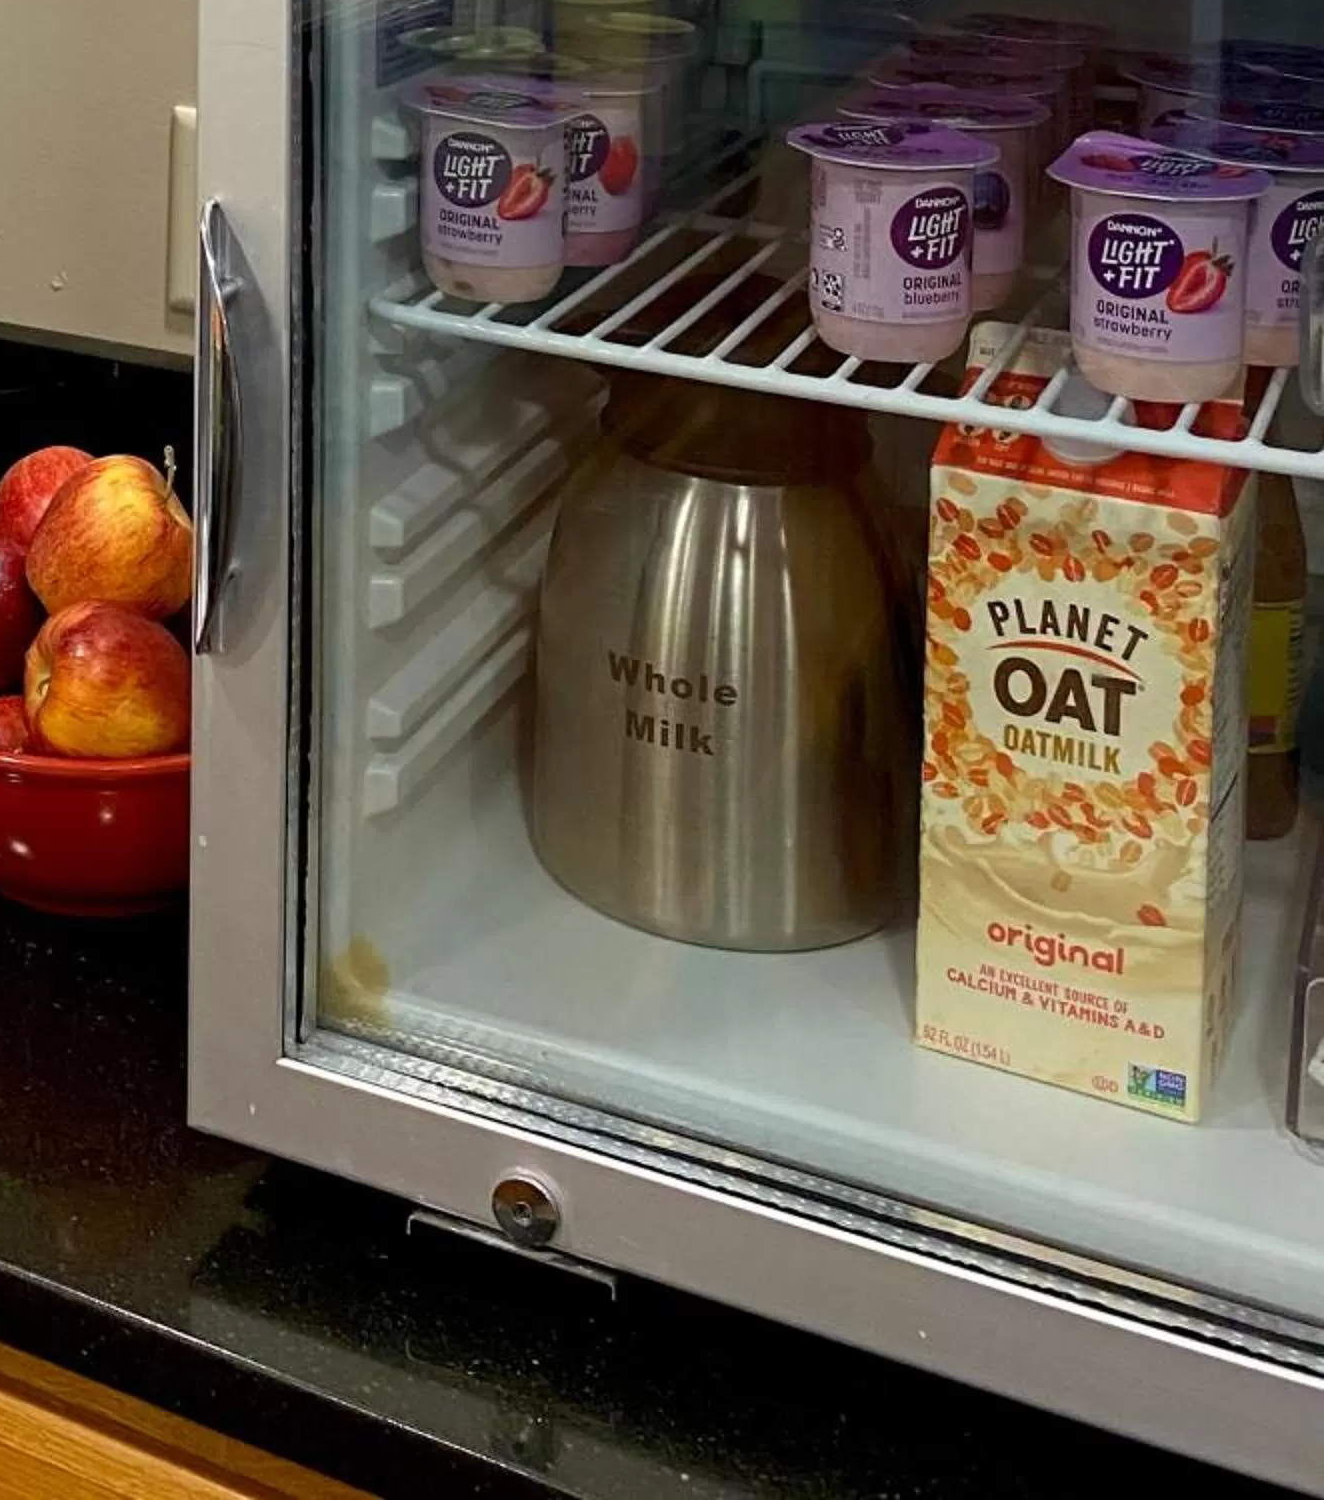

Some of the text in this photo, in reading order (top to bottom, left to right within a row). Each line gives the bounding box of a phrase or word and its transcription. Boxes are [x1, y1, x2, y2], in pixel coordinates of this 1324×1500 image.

[443, 153, 500, 177] LIGHT
[437, 224, 503, 246] strawberry
[439, 208, 501, 230] ORIGINAL
[907, 207, 962, 242] LIGHT
[1107, 220, 1157, 237] DANNON
[1101, 238, 1169, 265] LIGHT
[903, 272, 963, 291] ORIGINAL
[1093, 316, 1173, 341] strawberry
[1096, 299, 1169, 325] ORIGINAL
[987, 598, 1149, 661] PLANET
[608, 651, 738, 707] Whole
[993, 656, 1137, 738] OAT
[626, 709, 714, 756] Milk
[1004, 724, 1122, 775] OATMILK
[987, 920, 1125, 975] original
[947, 967, 1017, 1001] CALCIUM
[1039, 995, 1120, 1029] VITAMINS
[979, 963, 1128, 1014] AN EXCELLENT SOURCE OF
